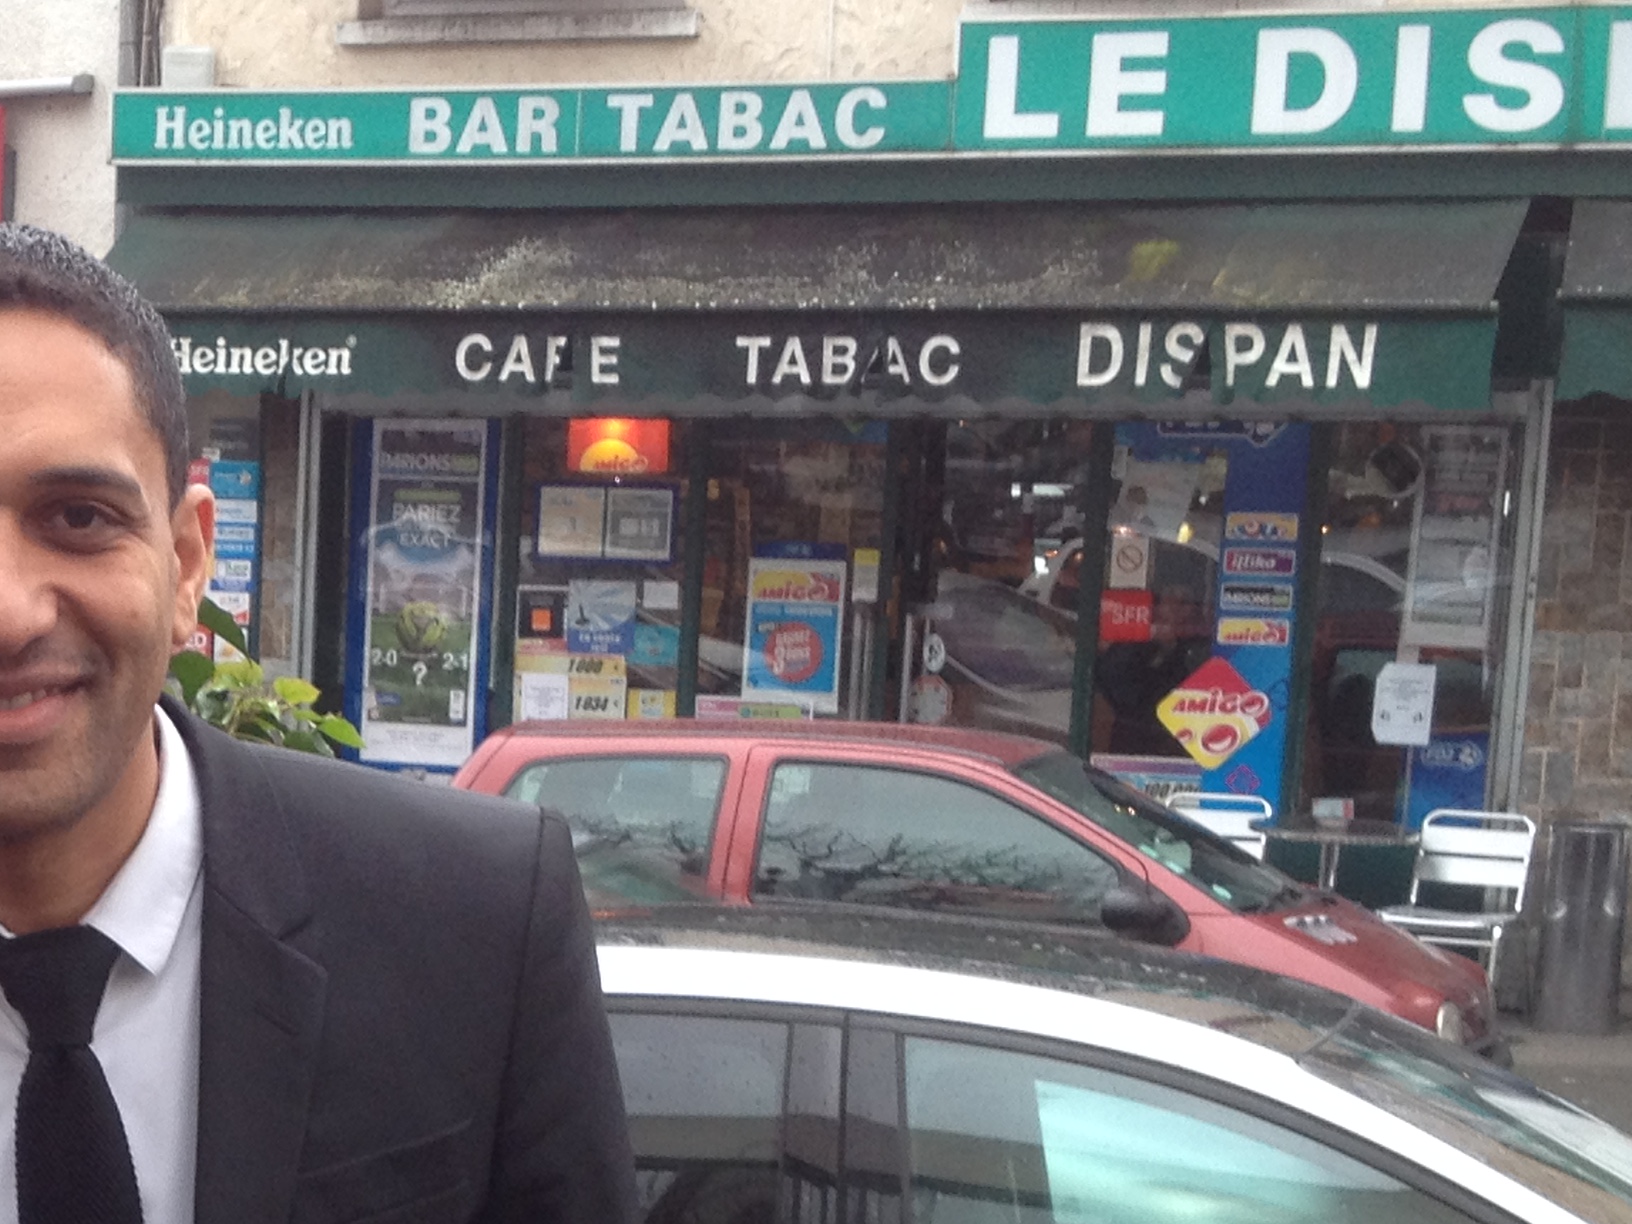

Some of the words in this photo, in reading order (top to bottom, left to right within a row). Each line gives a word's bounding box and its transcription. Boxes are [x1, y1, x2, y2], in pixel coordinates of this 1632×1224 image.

[983, 31, 1169, 139] LE
[1250, 18, 1632, 135] DIS
[154, 106, 354, 150] Heineken
[408, 96, 560, 154] BAR
[607, 87, 887, 152] TABAC
[455, 333, 620, 384] CAFE
[735, 334, 961, 386] TABAC
[1077, 321, 1378, 389] DISPAN
[392, 502, 462, 522] PARIEZ
[1112, 605, 1150, 625] SFR
